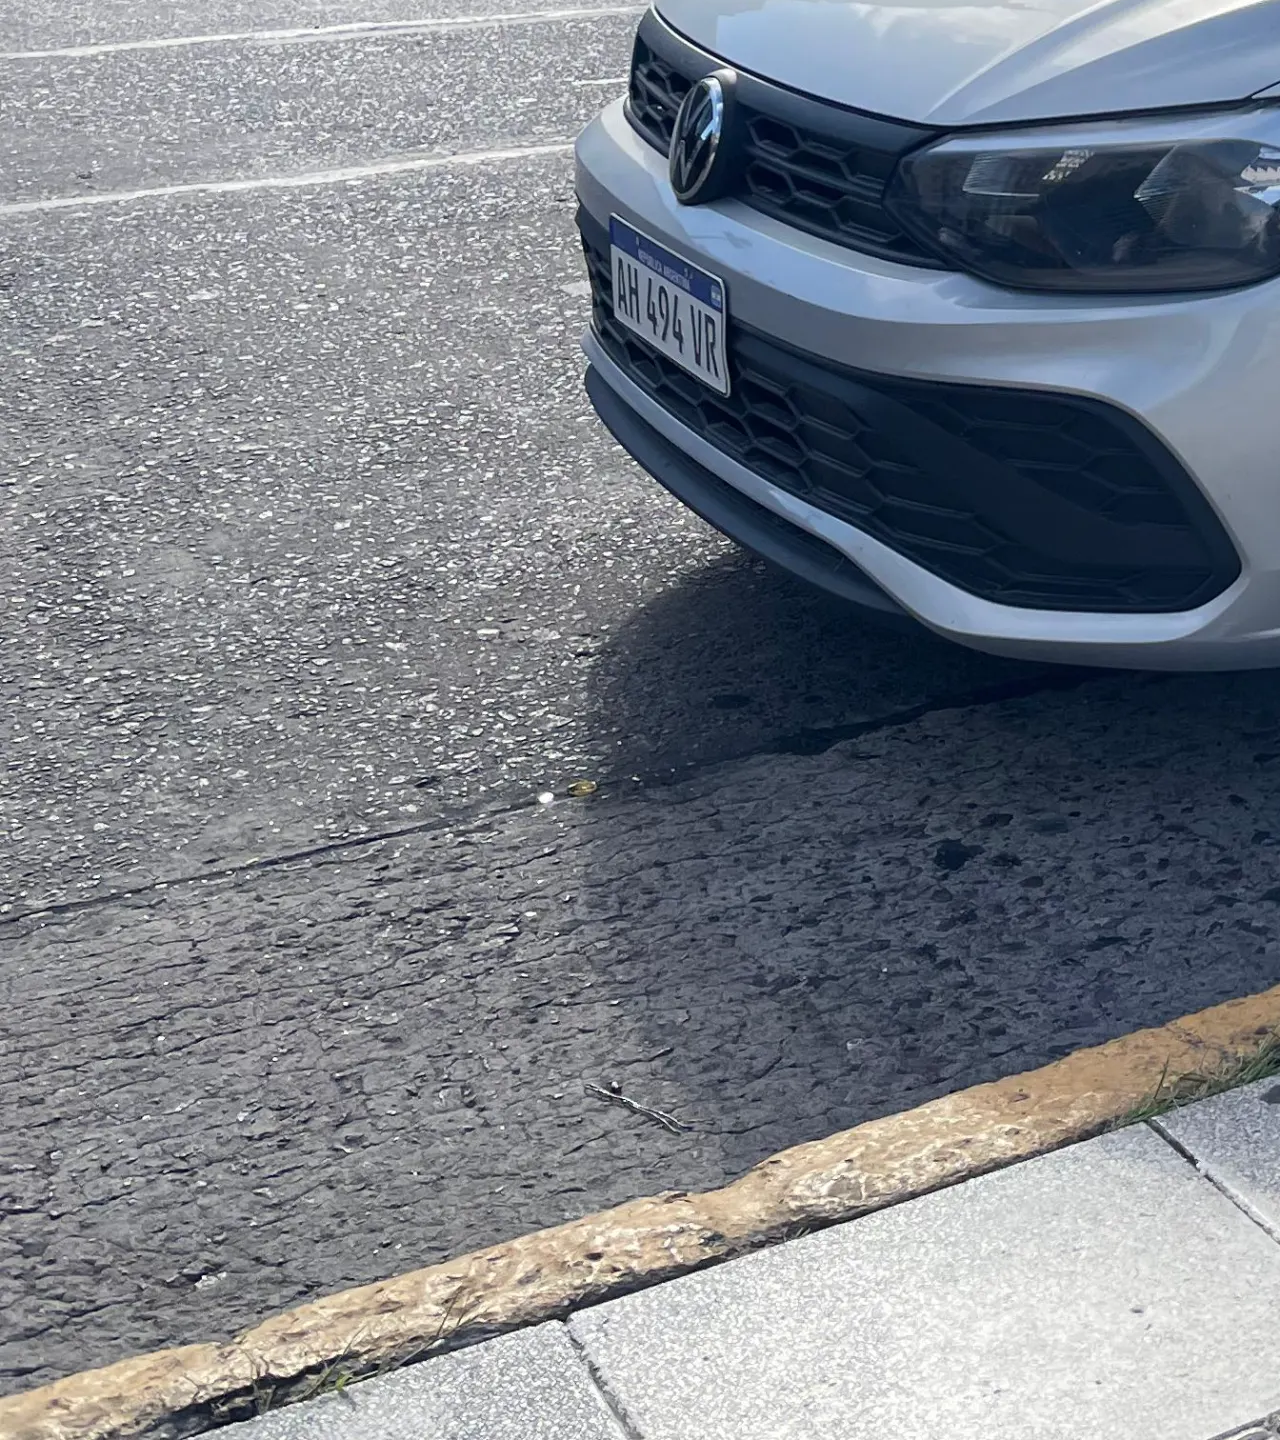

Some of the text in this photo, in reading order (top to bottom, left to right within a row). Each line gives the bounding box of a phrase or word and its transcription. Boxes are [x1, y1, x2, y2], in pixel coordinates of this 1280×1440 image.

[618, 257, 719, 379] AH 494 VR
